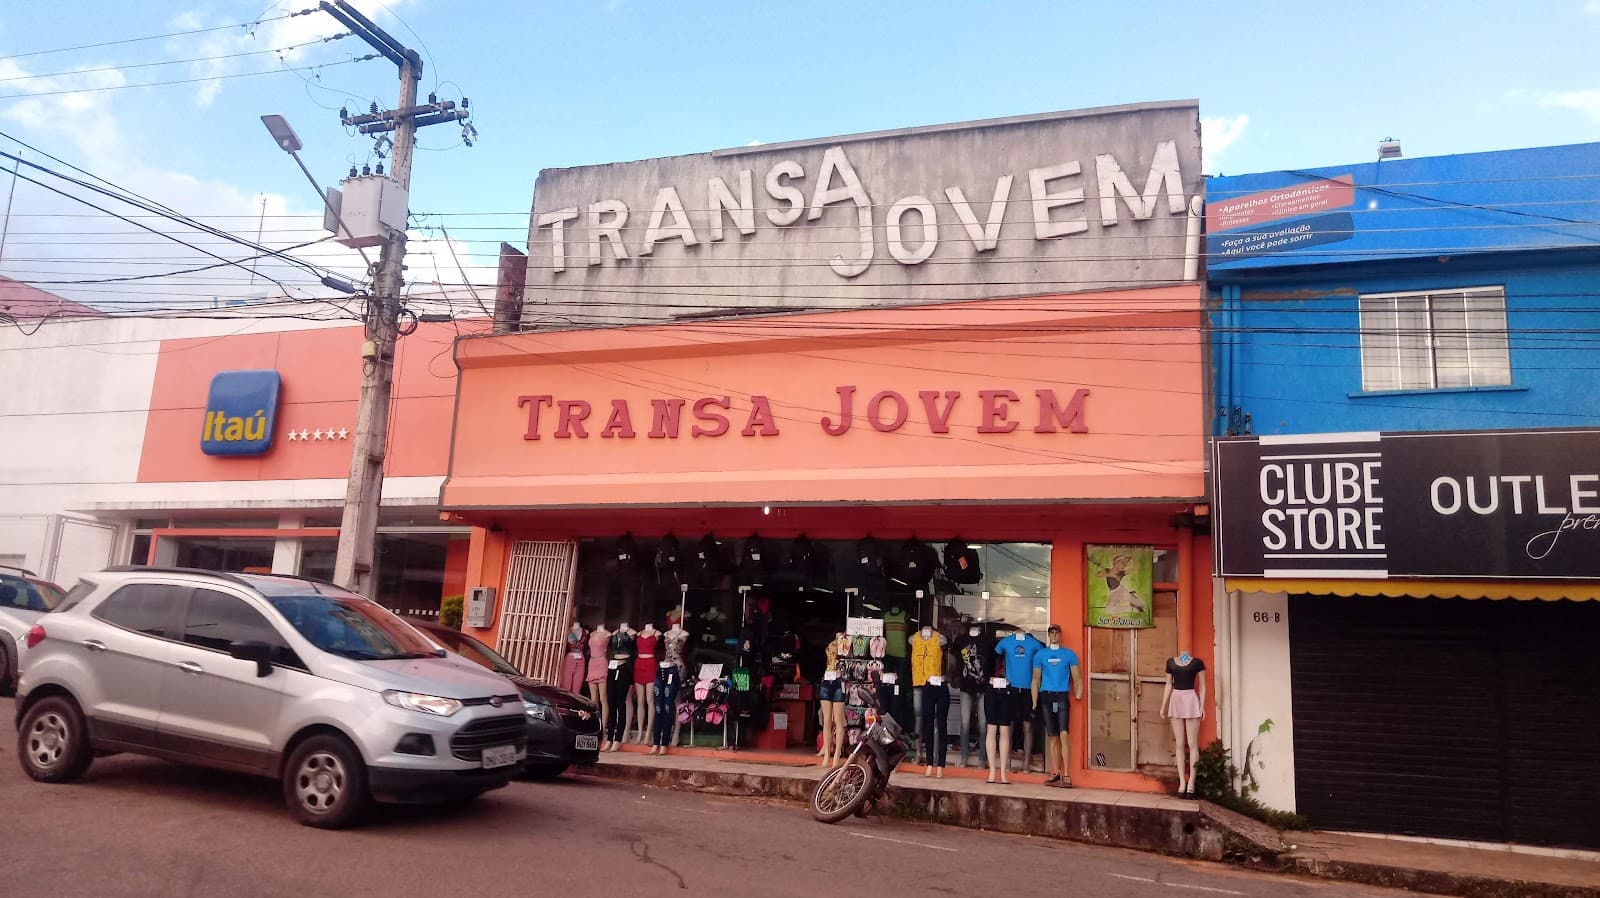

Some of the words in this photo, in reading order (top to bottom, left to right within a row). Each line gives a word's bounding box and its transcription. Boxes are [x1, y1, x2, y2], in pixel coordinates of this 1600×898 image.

[538, 146, 872, 274] TRANSA
[829, 139, 1186, 278] JOVEM
[1221, 198, 1269, 214] Aparelhos
[1224, 236, 1243, 248] Faça
[1251, 233, 1267, 242] sua
[1269, 224, 1311, 239] avaliação
[1224, 246, 1244, 257] Aqui
[1246, 240, 1266, 252] você
[1266, 236, 1288, 249] pode
[1289, 232, 1313, 244] sorrir
[203, 409, 267, 441] Itaú
[518, 395, 779, 441] TRANSA
[820, 385, 1091, 436] JOVEM
[1259, 461, 1384, 506] CLUBE
[1430, 474, 1600, 515] OUTLE
[1261, 507, 1386, 551] STORE
[1253, 611, 1269, 623] 66
[1274, 611, 1280, 623] B
